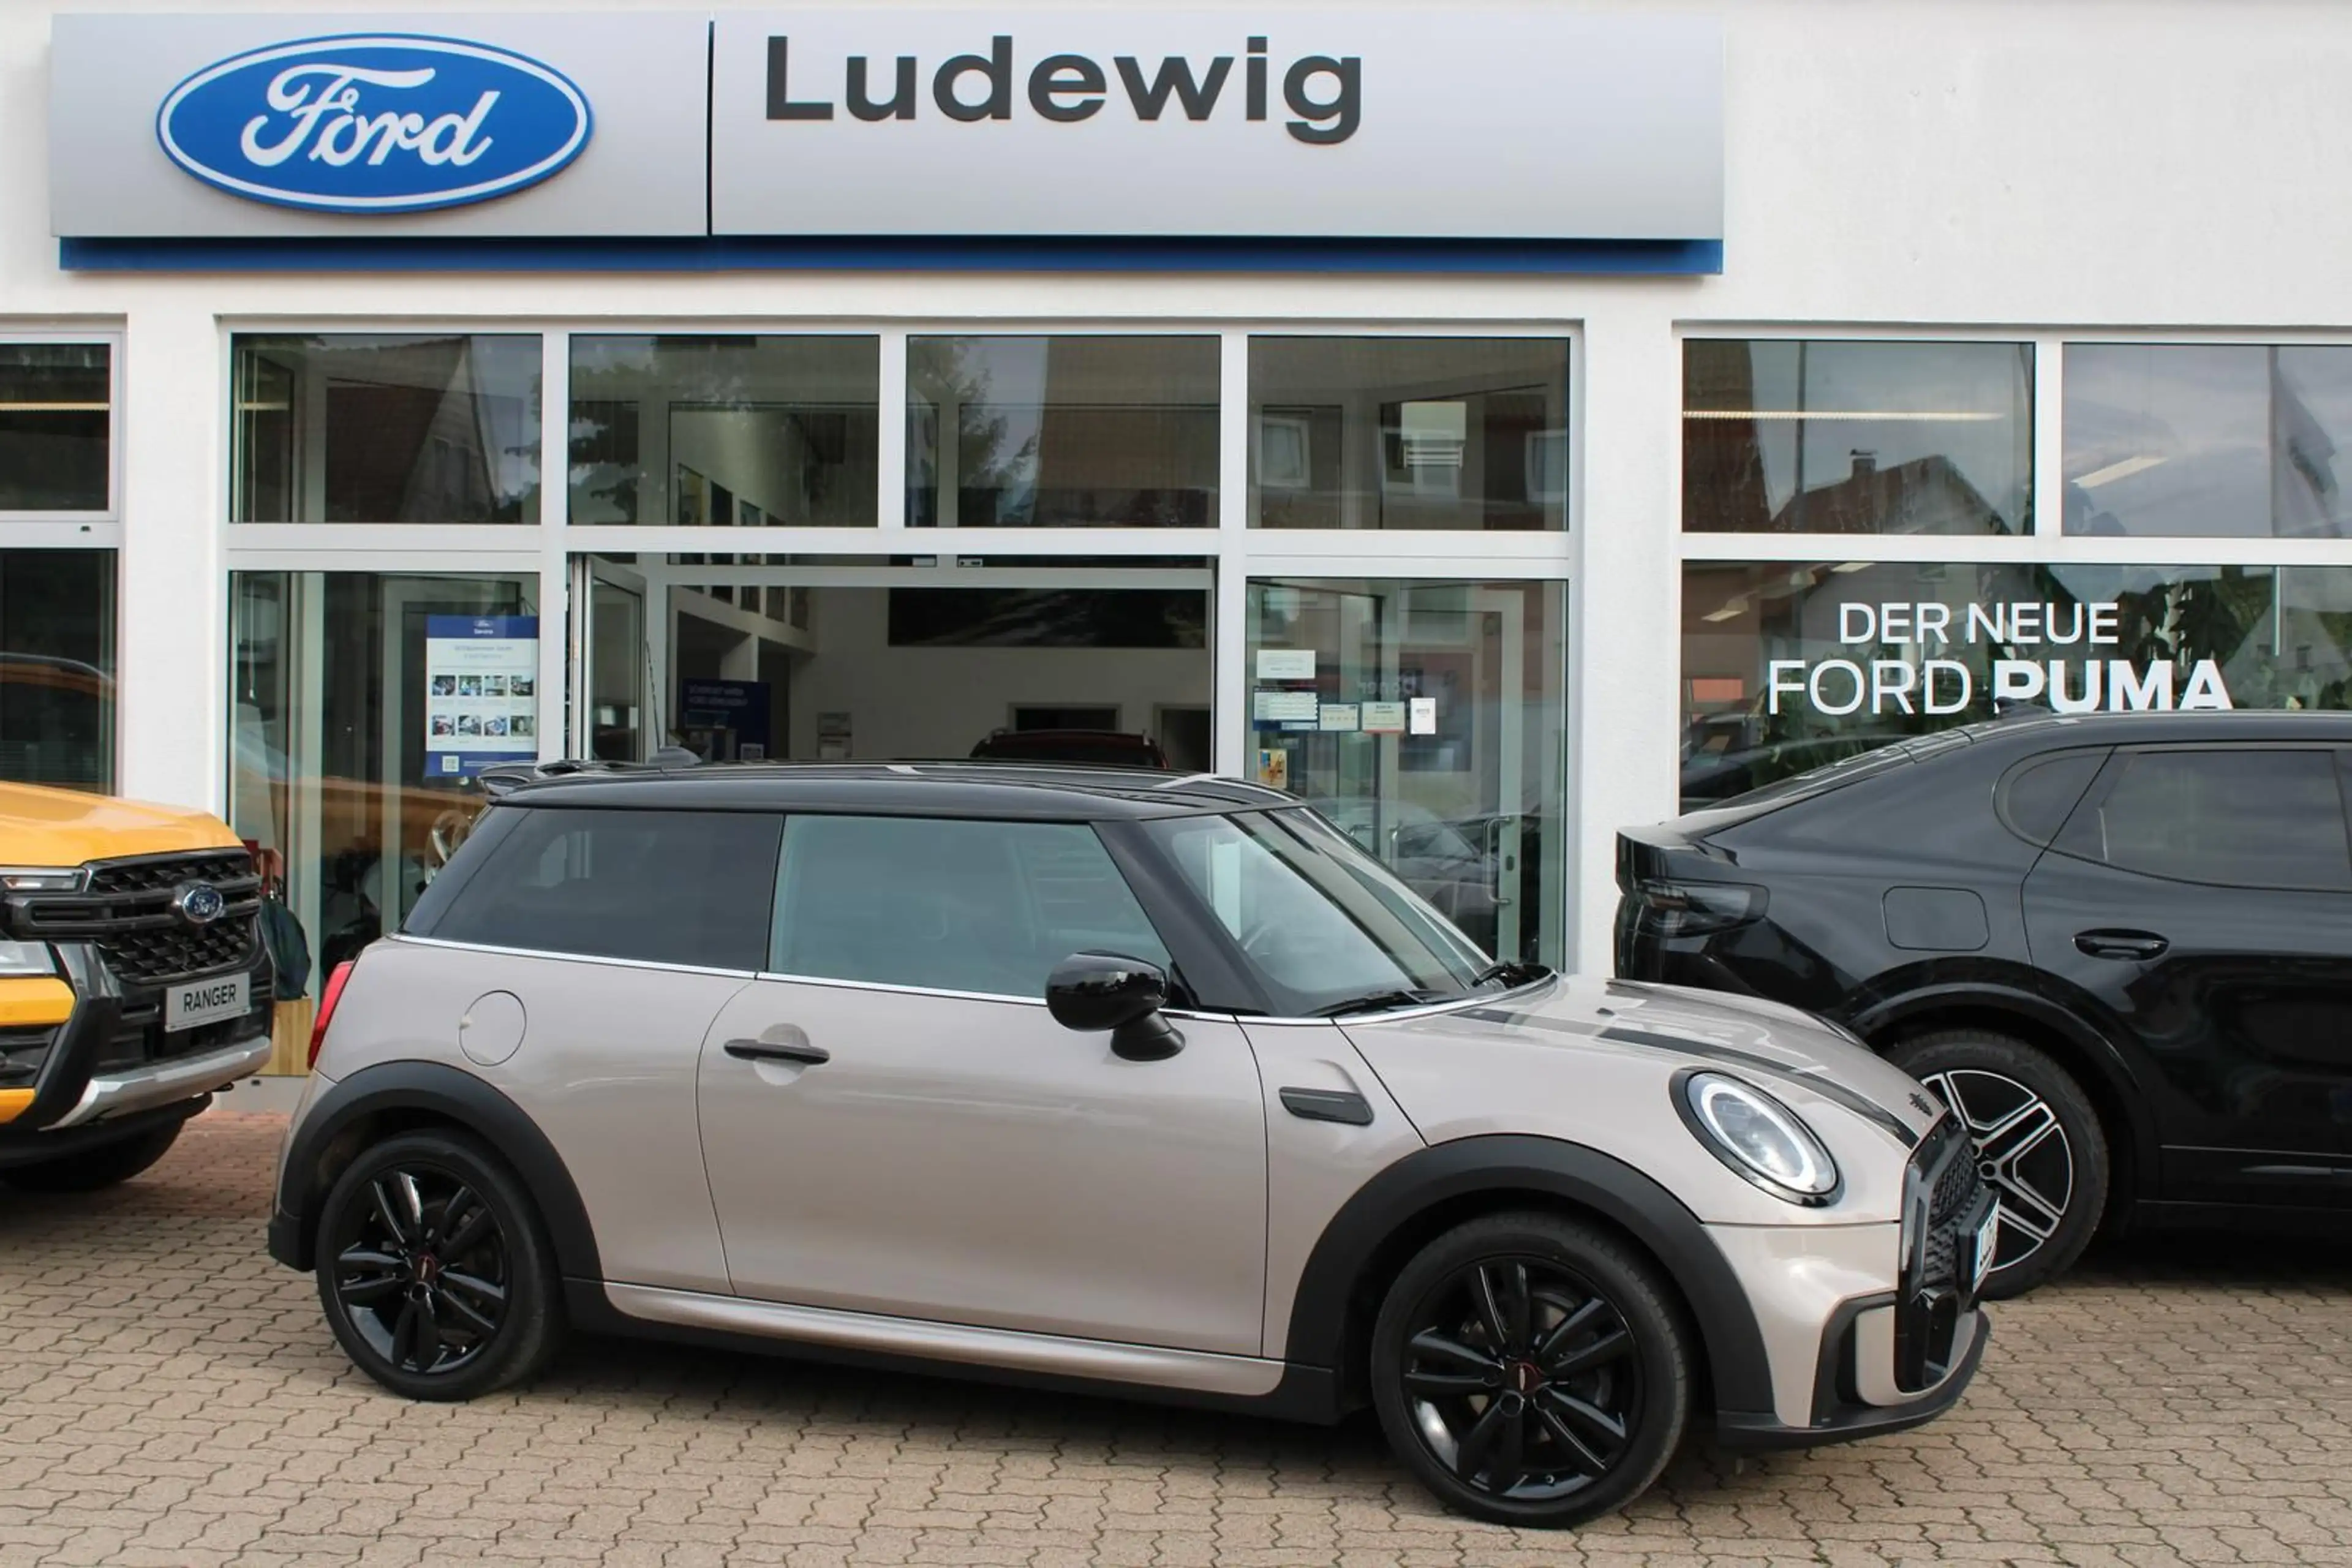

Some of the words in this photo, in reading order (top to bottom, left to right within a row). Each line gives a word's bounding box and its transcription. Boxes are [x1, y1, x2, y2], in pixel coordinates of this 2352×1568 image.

[239, 62, 500, 167] Ford
[766, 36, 1361, 145] Ludewig
[1840, 602, 1950, 644] DER
[1967, 602, 2119, 644] NEUE
[1769, 660, 1972, 715] FORD
[1994, 660, 2233, 714] PUMA
[183, 983, 236, 1012] RANGER
